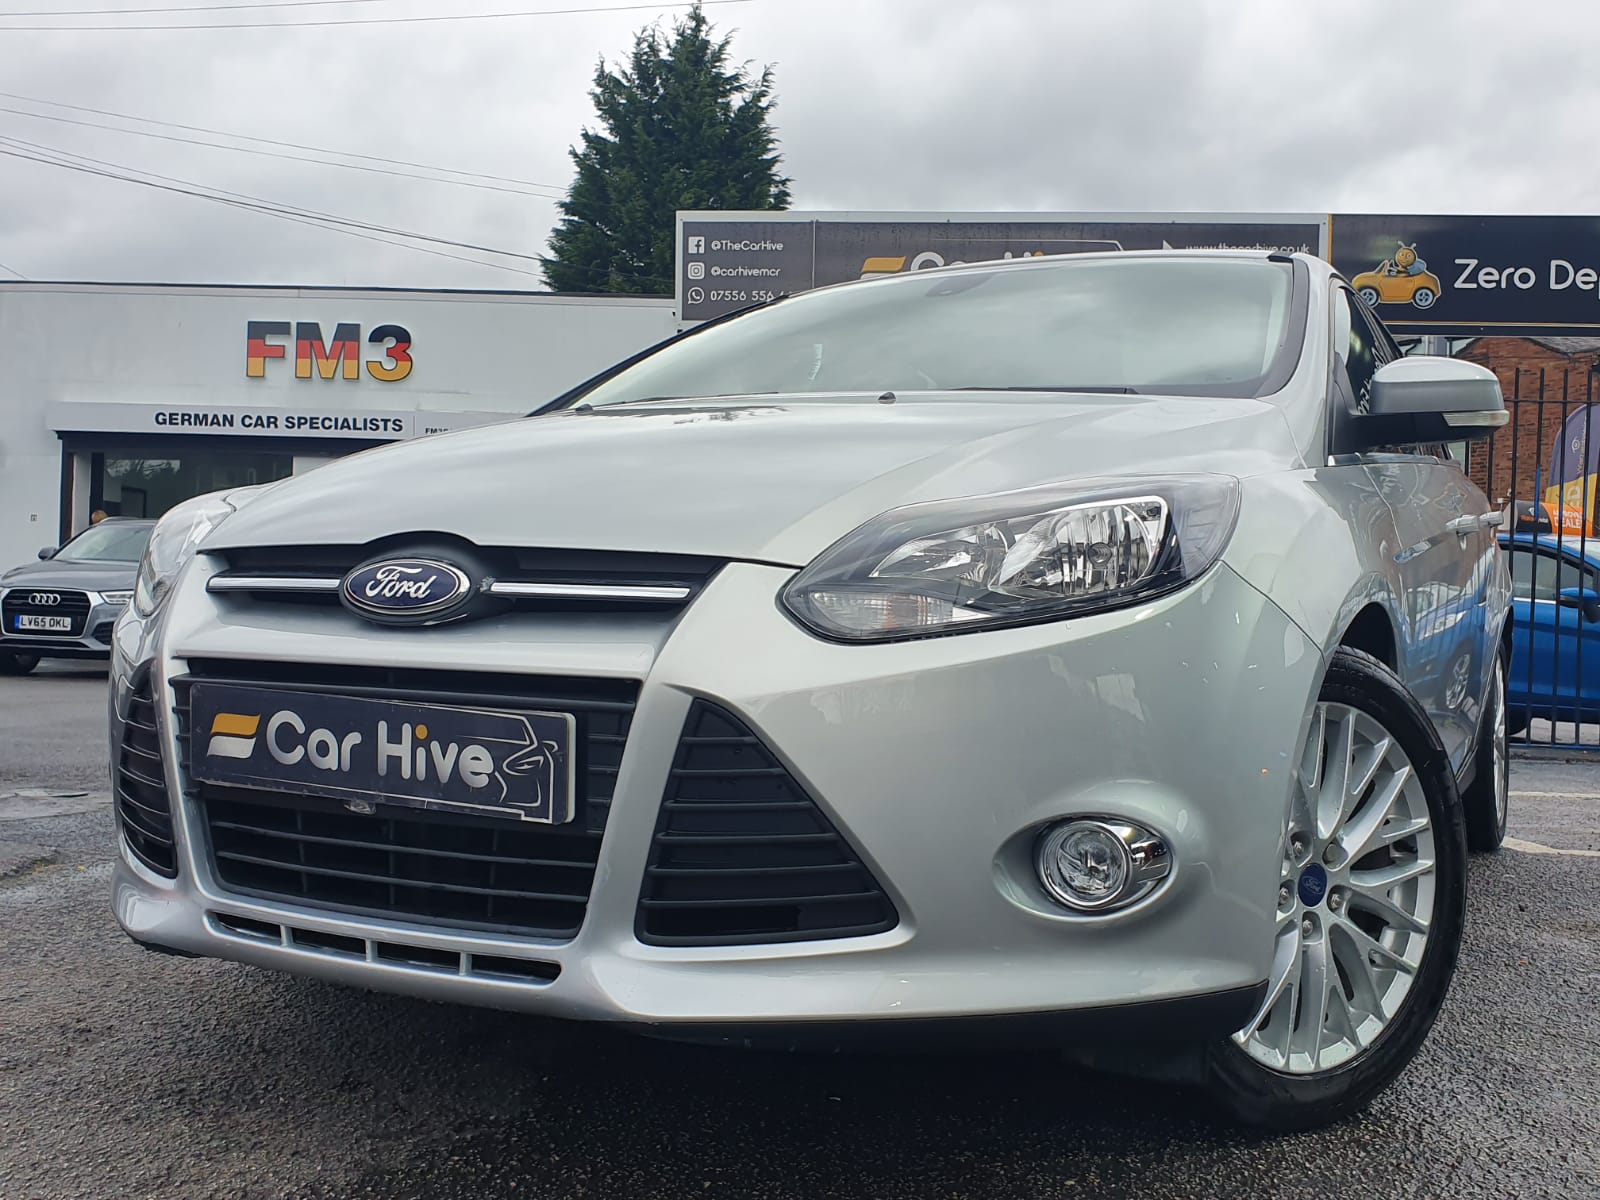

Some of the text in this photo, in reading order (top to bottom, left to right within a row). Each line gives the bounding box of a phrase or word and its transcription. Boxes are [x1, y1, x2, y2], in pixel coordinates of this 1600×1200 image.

[711, 240, 784, 251] @TheCarHive
[1186, 243, 1310, 253] wwwthecarhivecouk
[711, 266, 781, 277] @carhivemcr
[1454, 259, 1600, 300] Zero De
[711, 291, 747, 301] 07556
[752, 291, 775, 302] 556
[246, 321, 413, 382] FM3
[155, 411, 404, 433] GERMAN CAR SPECIALISTS
[365, 565, 437, 599] Ford
[21, 617, 69, 629] LV65 OKL
[266, 710, 495, 788] Car Hive
